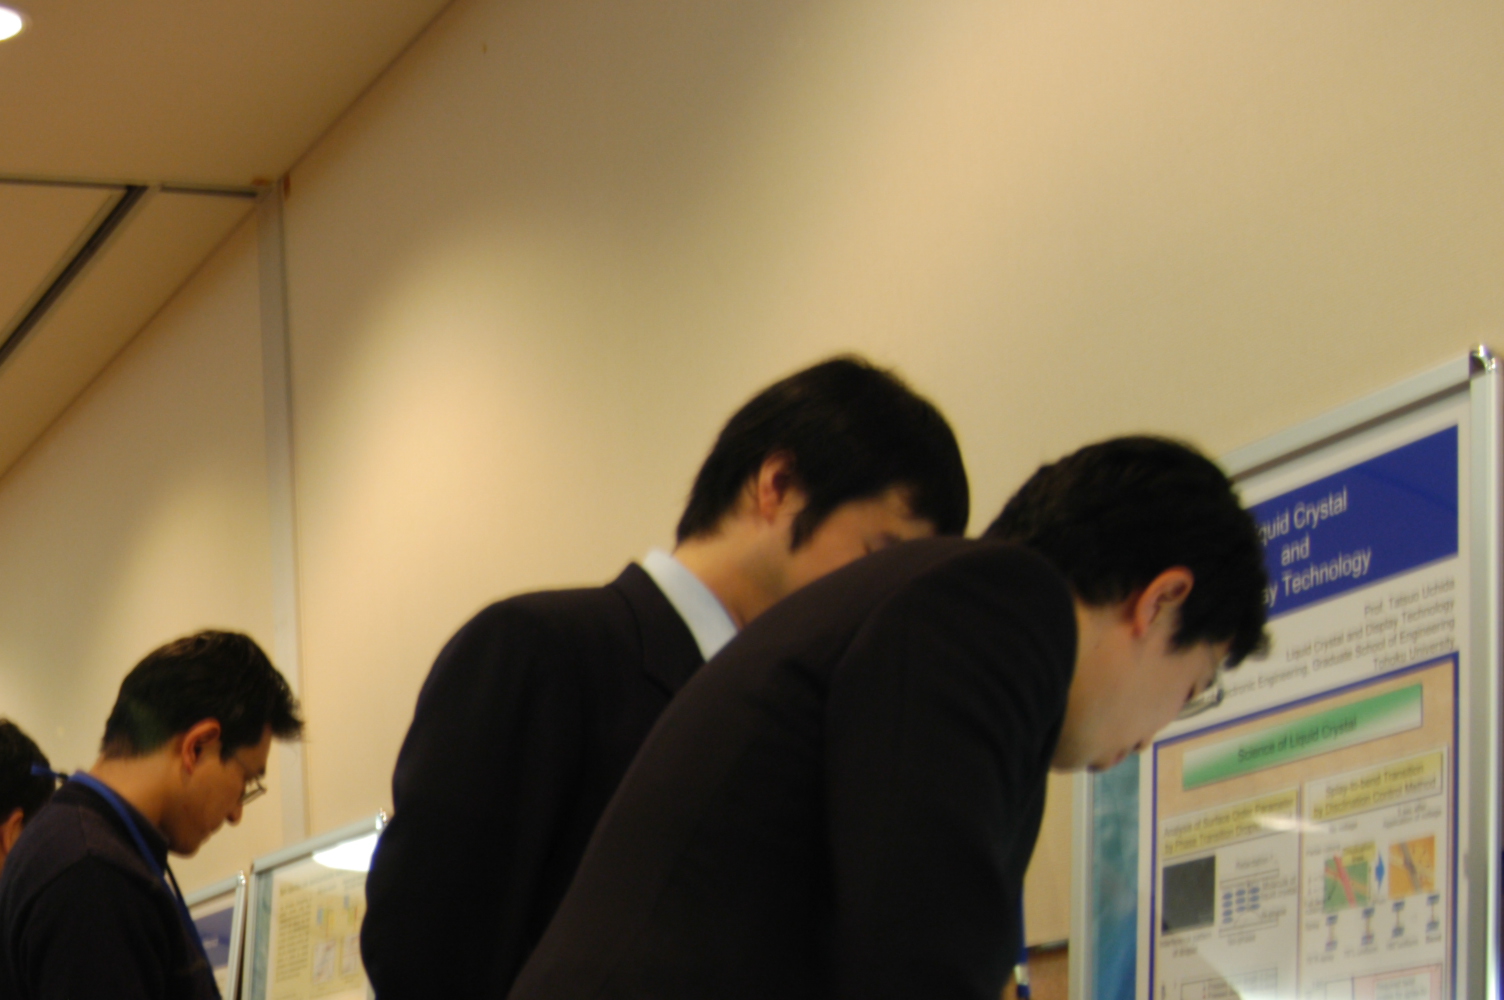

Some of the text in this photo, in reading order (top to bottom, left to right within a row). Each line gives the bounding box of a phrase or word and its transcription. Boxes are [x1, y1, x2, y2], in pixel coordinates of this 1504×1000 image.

[1256, 484, 1347, 548] quid Crystal
[1281, 532, 1310, 566] and
[1281, 546, 1372, 597] Technology
[1401, 598, 1455, 623] Technology
[1400, 618, 1455, 645] Engineering
[1409, 637, 1454, 661] University
[1237, 743, 1275, 763] Science
[1289, 726, 1319, 750] Liquid
[1321, 715, 1358, 741] Crystal
